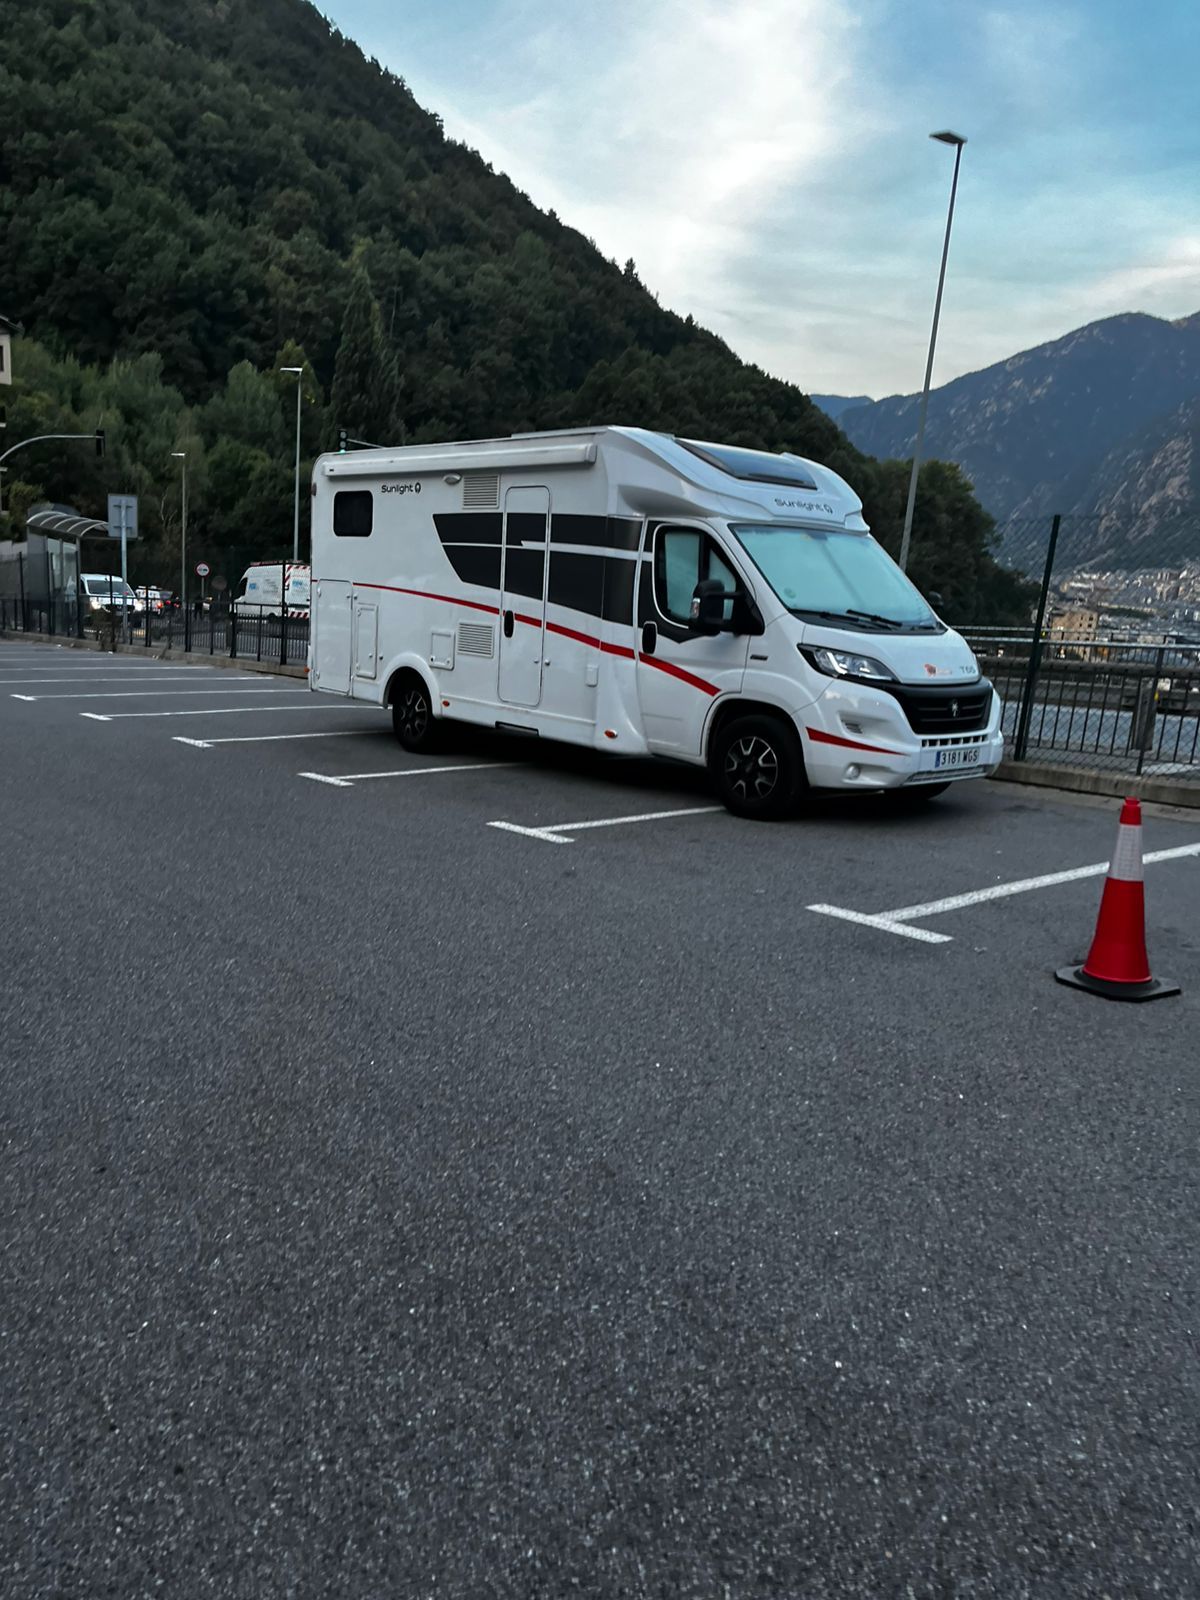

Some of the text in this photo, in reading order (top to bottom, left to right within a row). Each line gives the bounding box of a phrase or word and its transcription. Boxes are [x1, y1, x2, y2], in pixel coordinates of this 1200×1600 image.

[381, 484, 414, 495] Sunlight
[774, 498, 825, 512] Sunlight
[941, 750, 961, 765] 3181
